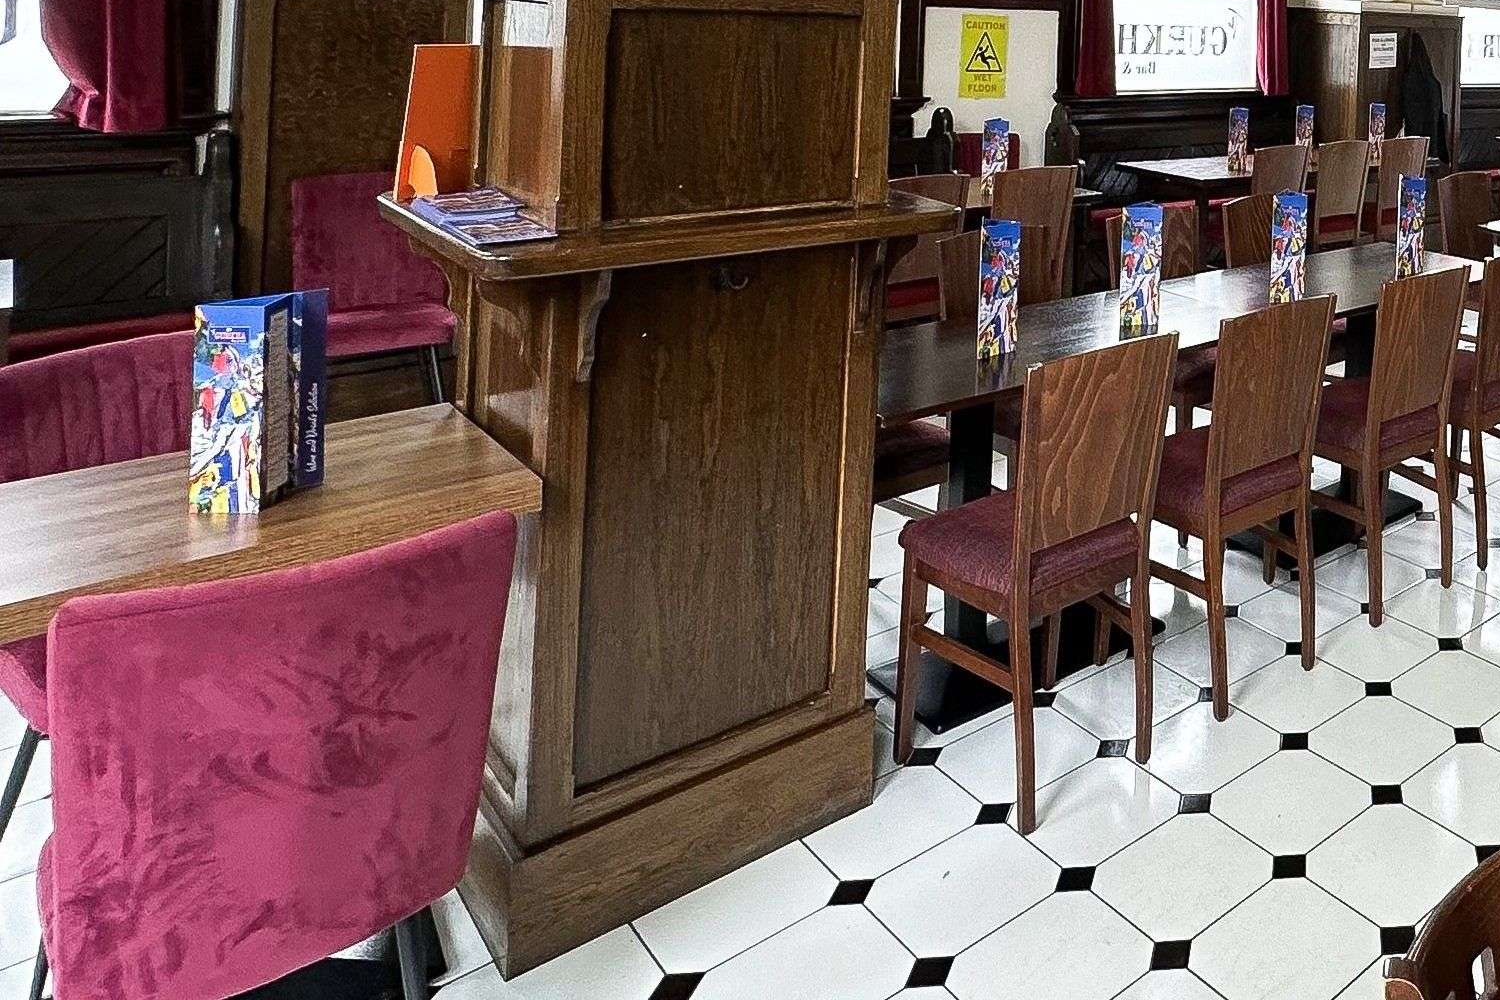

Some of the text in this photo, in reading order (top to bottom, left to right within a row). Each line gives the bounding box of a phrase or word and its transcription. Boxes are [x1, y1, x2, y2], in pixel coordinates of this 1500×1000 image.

[966, 20, 1006, 30] CAUTION
[973, 73, 992, 82] WET
[967, 83, 997, 93] FLOOR
